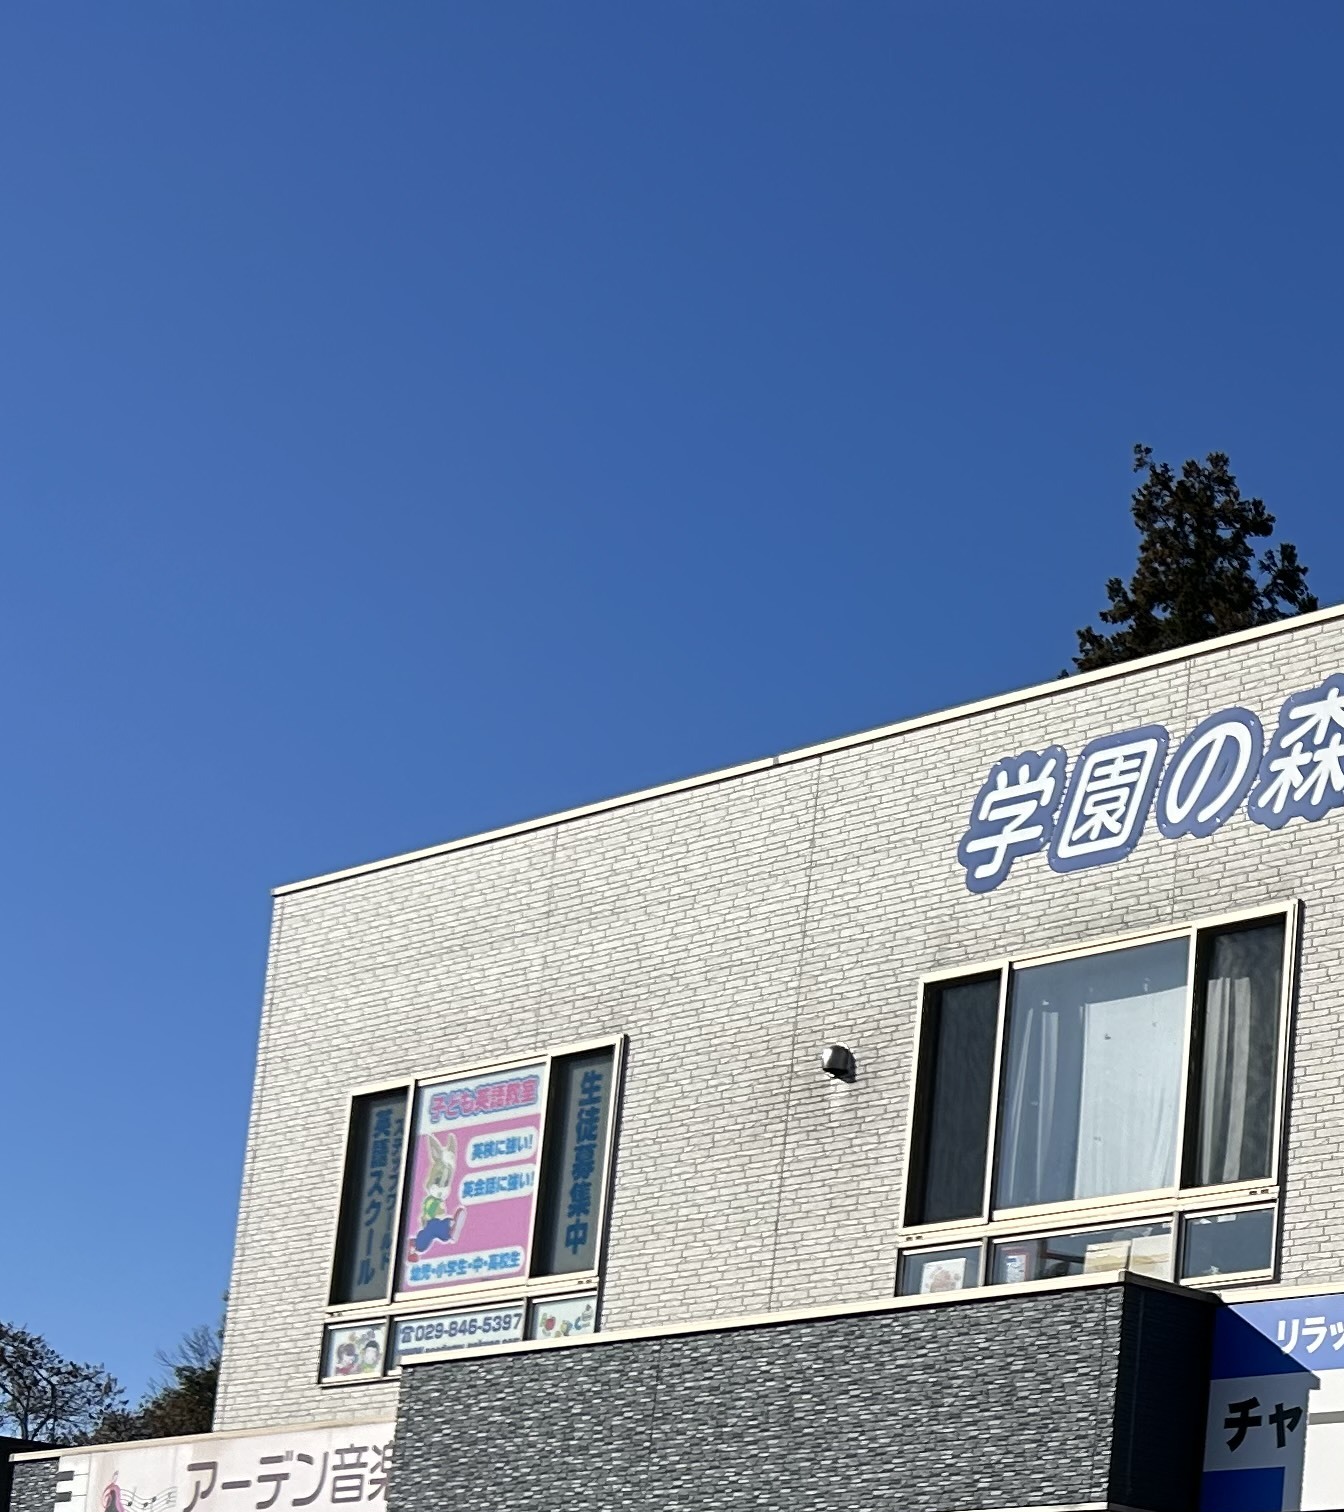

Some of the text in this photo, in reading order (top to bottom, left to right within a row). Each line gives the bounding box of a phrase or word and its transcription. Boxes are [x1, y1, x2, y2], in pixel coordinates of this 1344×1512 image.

[565, 1070, 603, 1255] 生徒募集中
